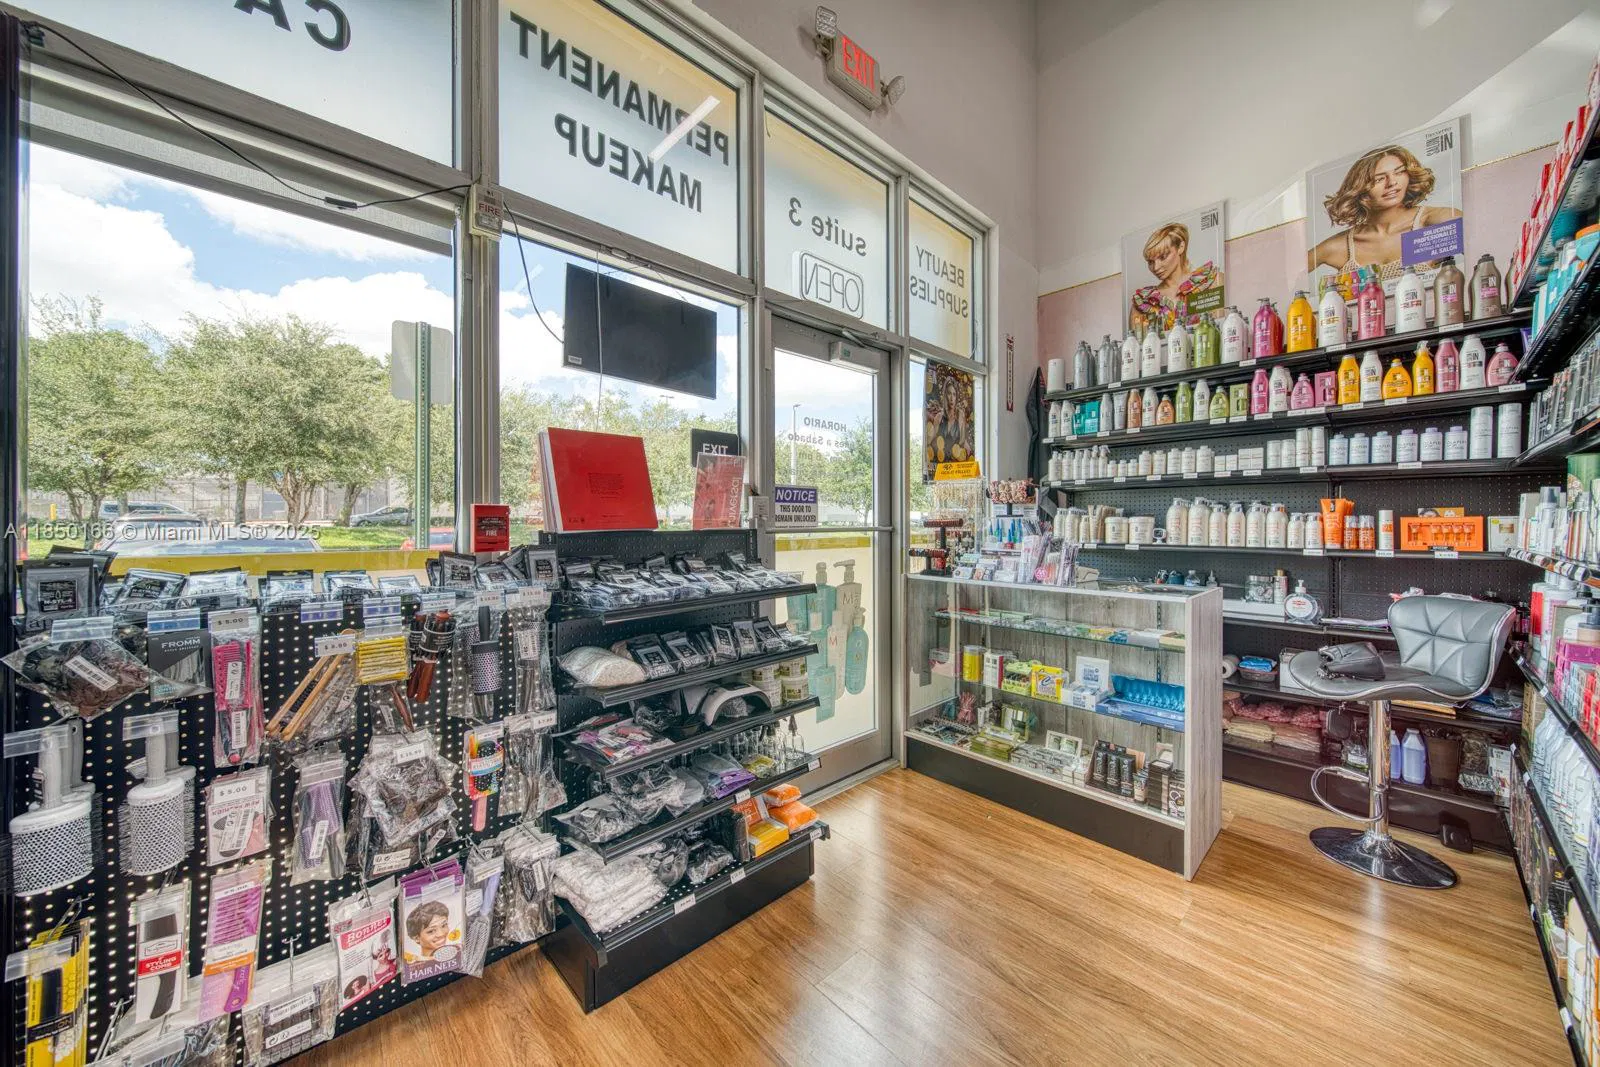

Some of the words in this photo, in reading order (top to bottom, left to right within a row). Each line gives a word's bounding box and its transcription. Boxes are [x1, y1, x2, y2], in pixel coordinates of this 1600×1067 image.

[842, 35, 876, 97] EXIT
[478, 203, 500, 217] FIRE
[702, 443, 728, 455] EXIT
[776, 488, 815, 502] NOTICE
[780, 505, 791, 513] THIS
[791, 505, 804, 513] DOOR
[775, 514, 793, 522] REMAIN
[161, 639, 200, 649] FROMM
[409, 966, 433, 980] HAIR
[434, 959, 457, 972] NETS
